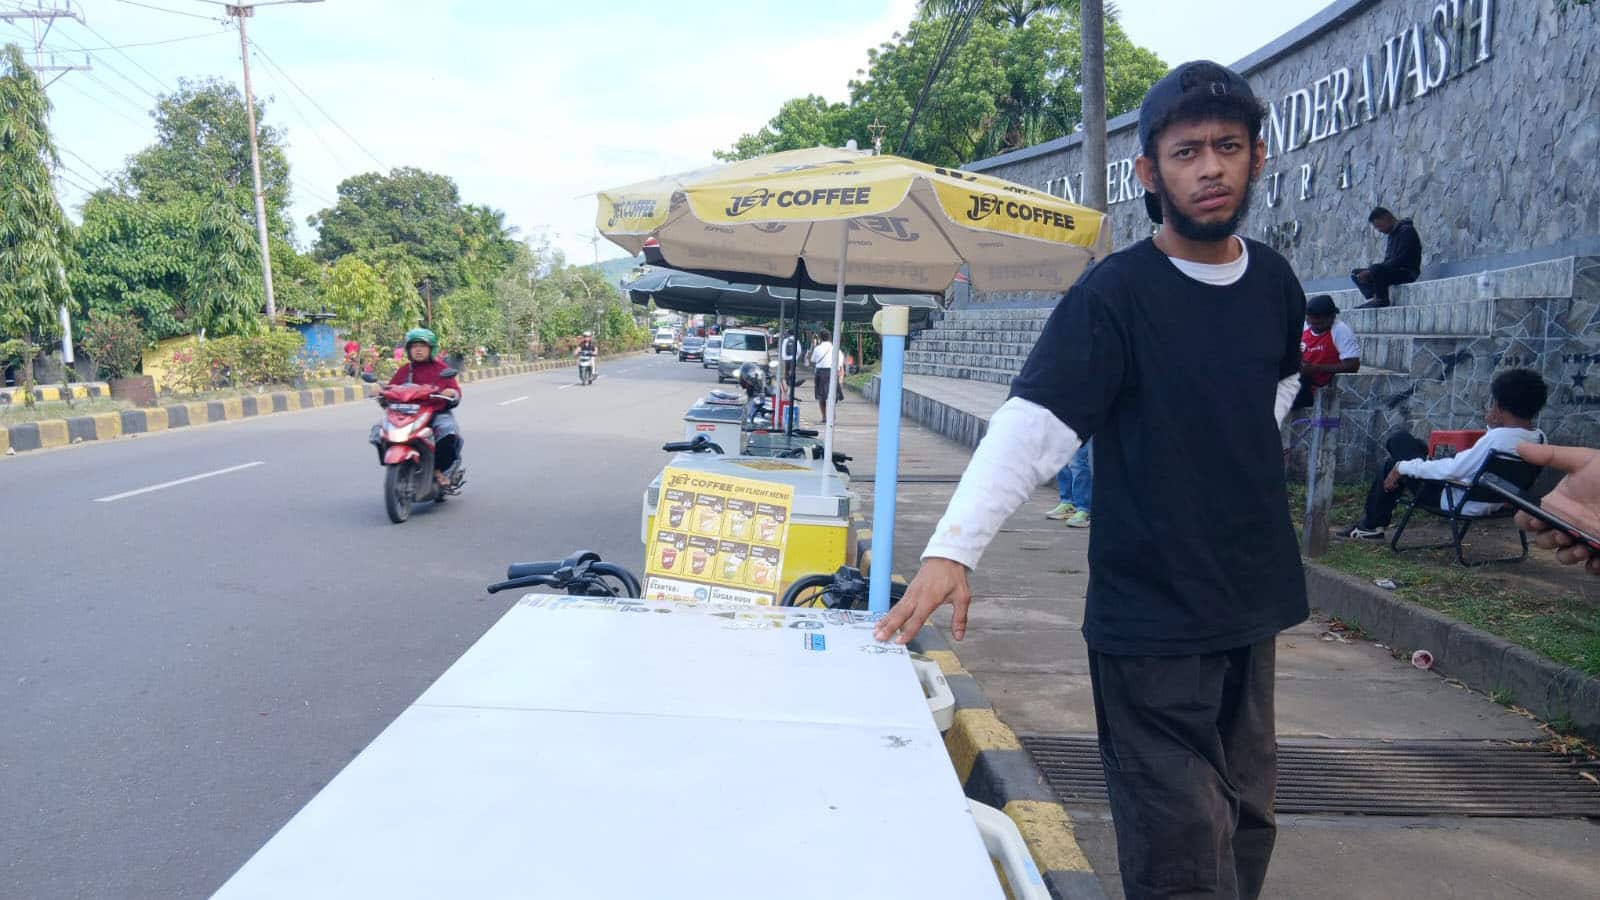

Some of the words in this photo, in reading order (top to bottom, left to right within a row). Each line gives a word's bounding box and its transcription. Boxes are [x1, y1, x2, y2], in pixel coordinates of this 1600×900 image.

[726, 188, 776, 216] JET
[777, 186, 871, 208] COFFEE
[967, 193, 1003, 220] JET
[1006, 201, 1075, 230] COFFEE
[667, 474, 690, 487] JET
[691, 479, 735, 492] COFFEE
